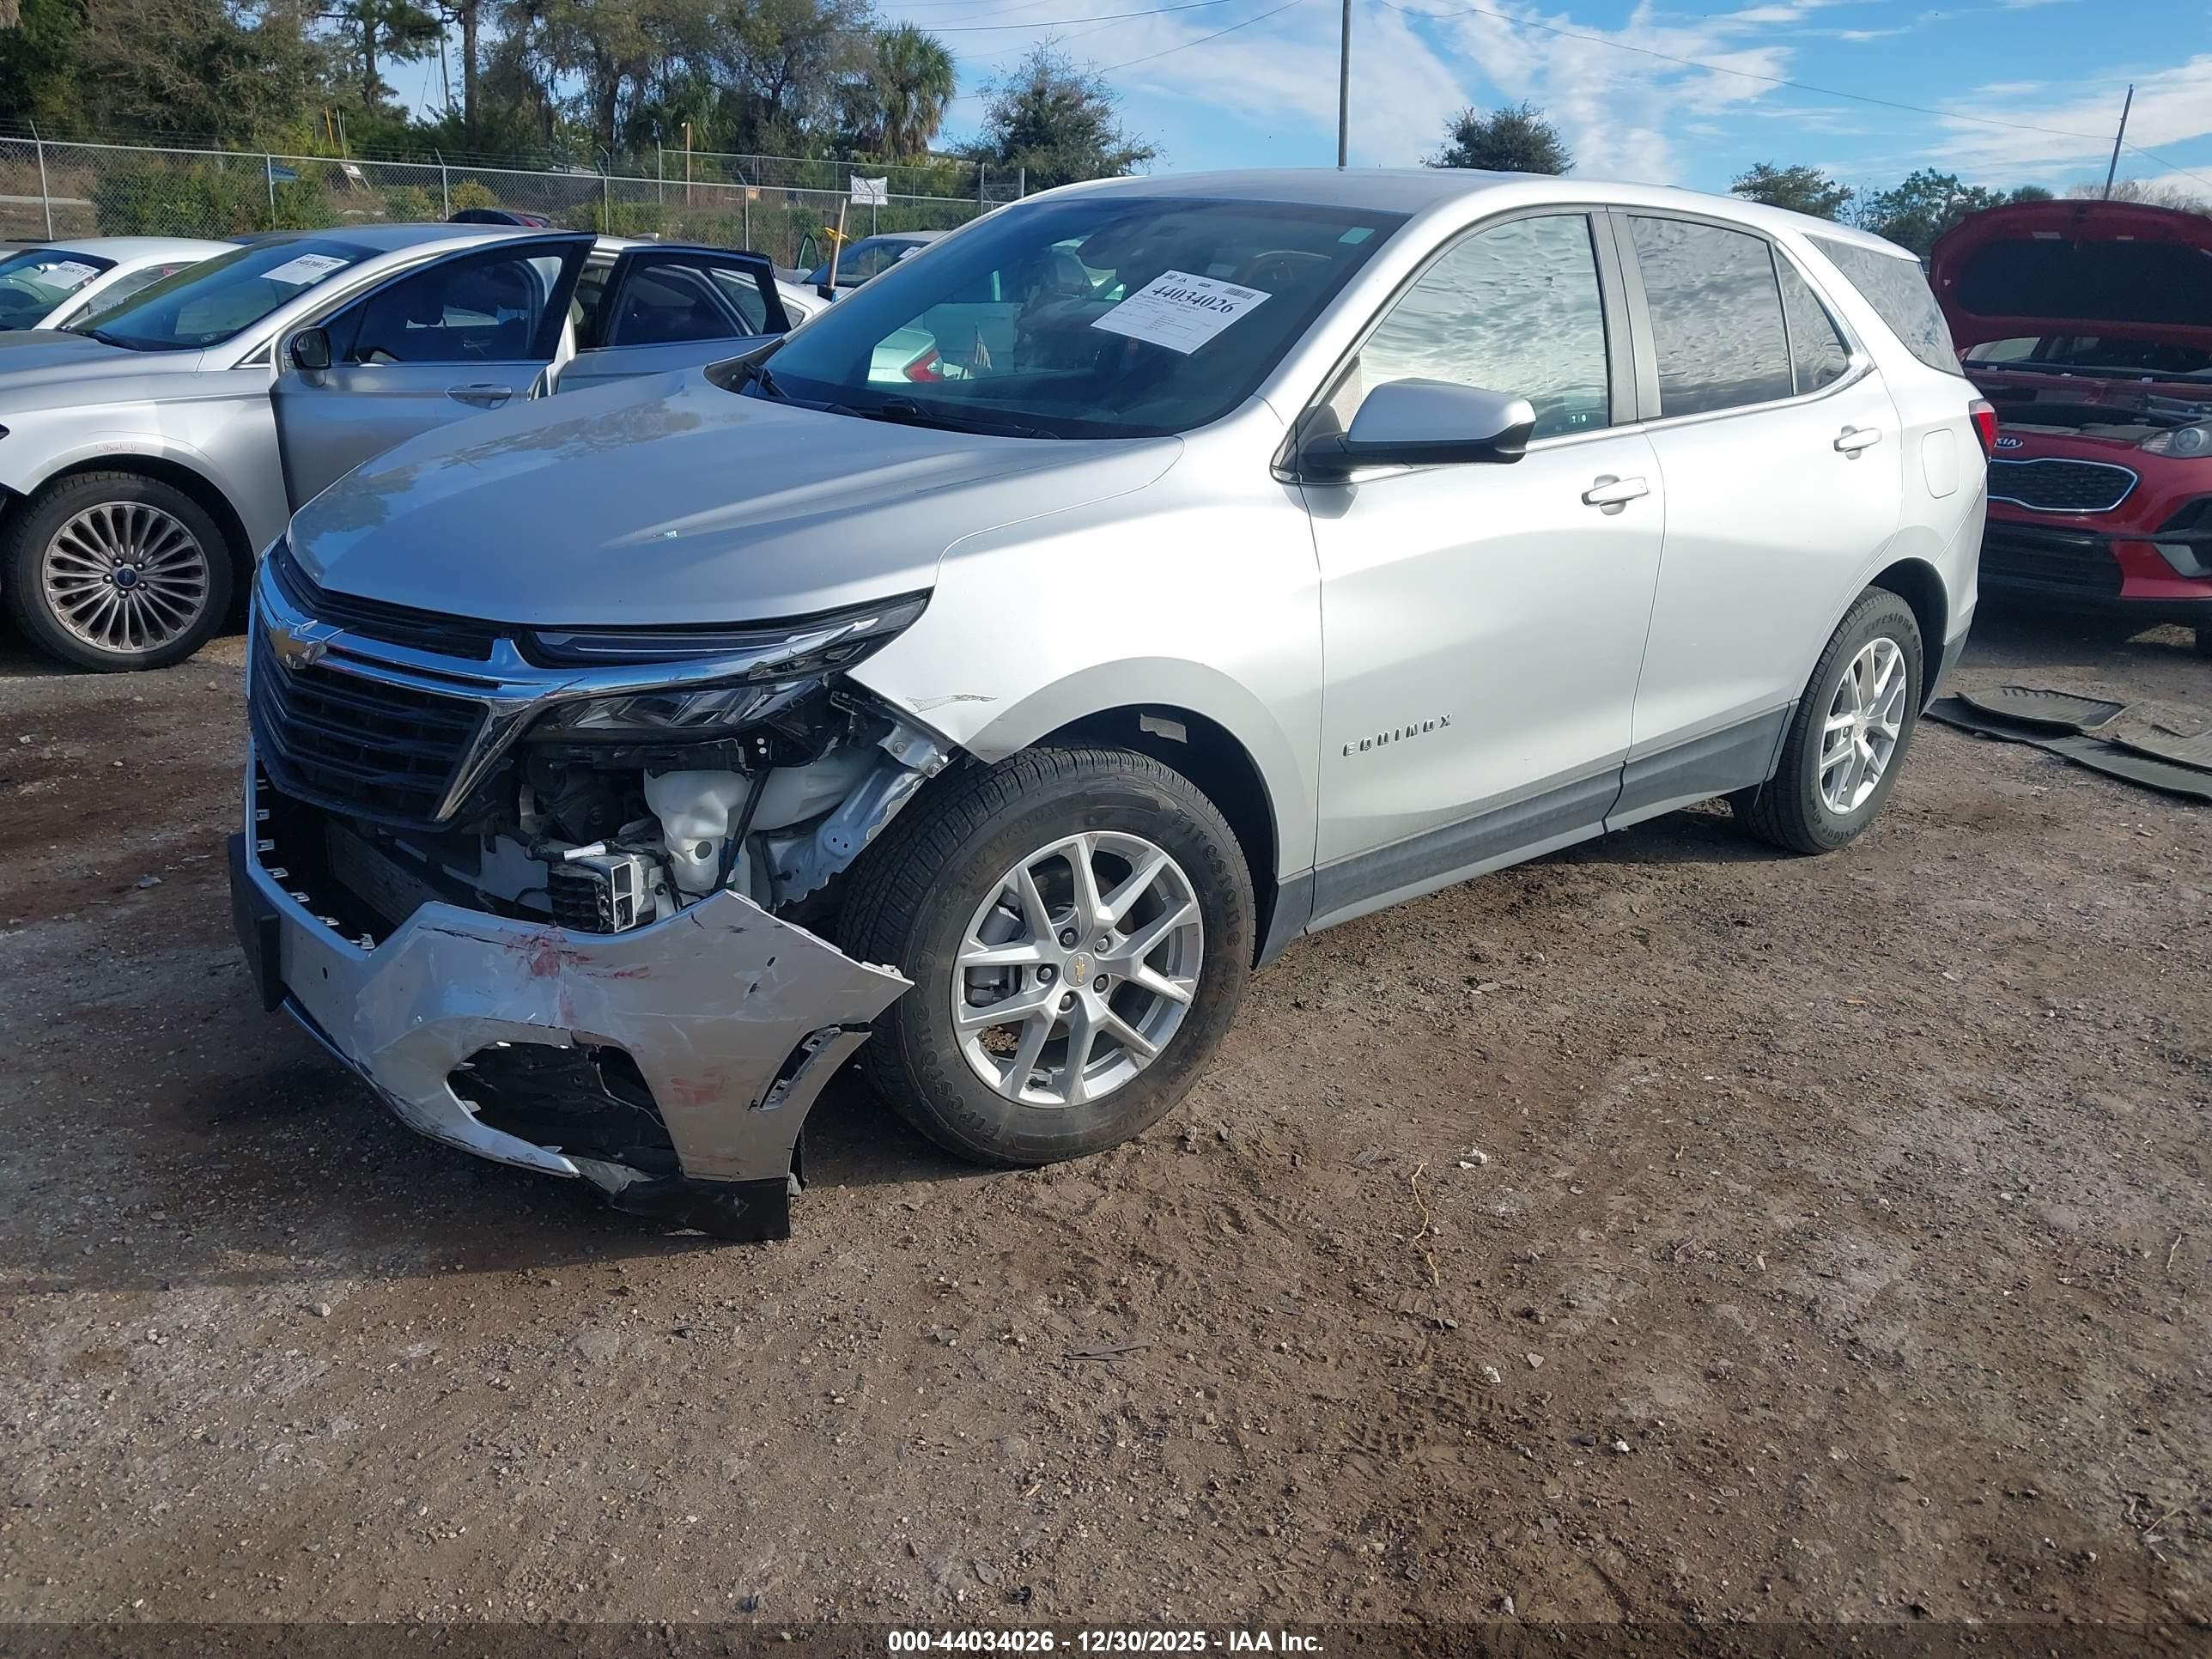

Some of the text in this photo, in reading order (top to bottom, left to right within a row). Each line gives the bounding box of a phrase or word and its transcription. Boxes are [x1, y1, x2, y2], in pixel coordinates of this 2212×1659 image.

[1152, 284, 1242, 313] 44034026
[1342, 714, 1453, 757] EQUINOX
[1171, 805, 1242, 948] Firestone
[914, 1003, 1004, 1142] Firestone
